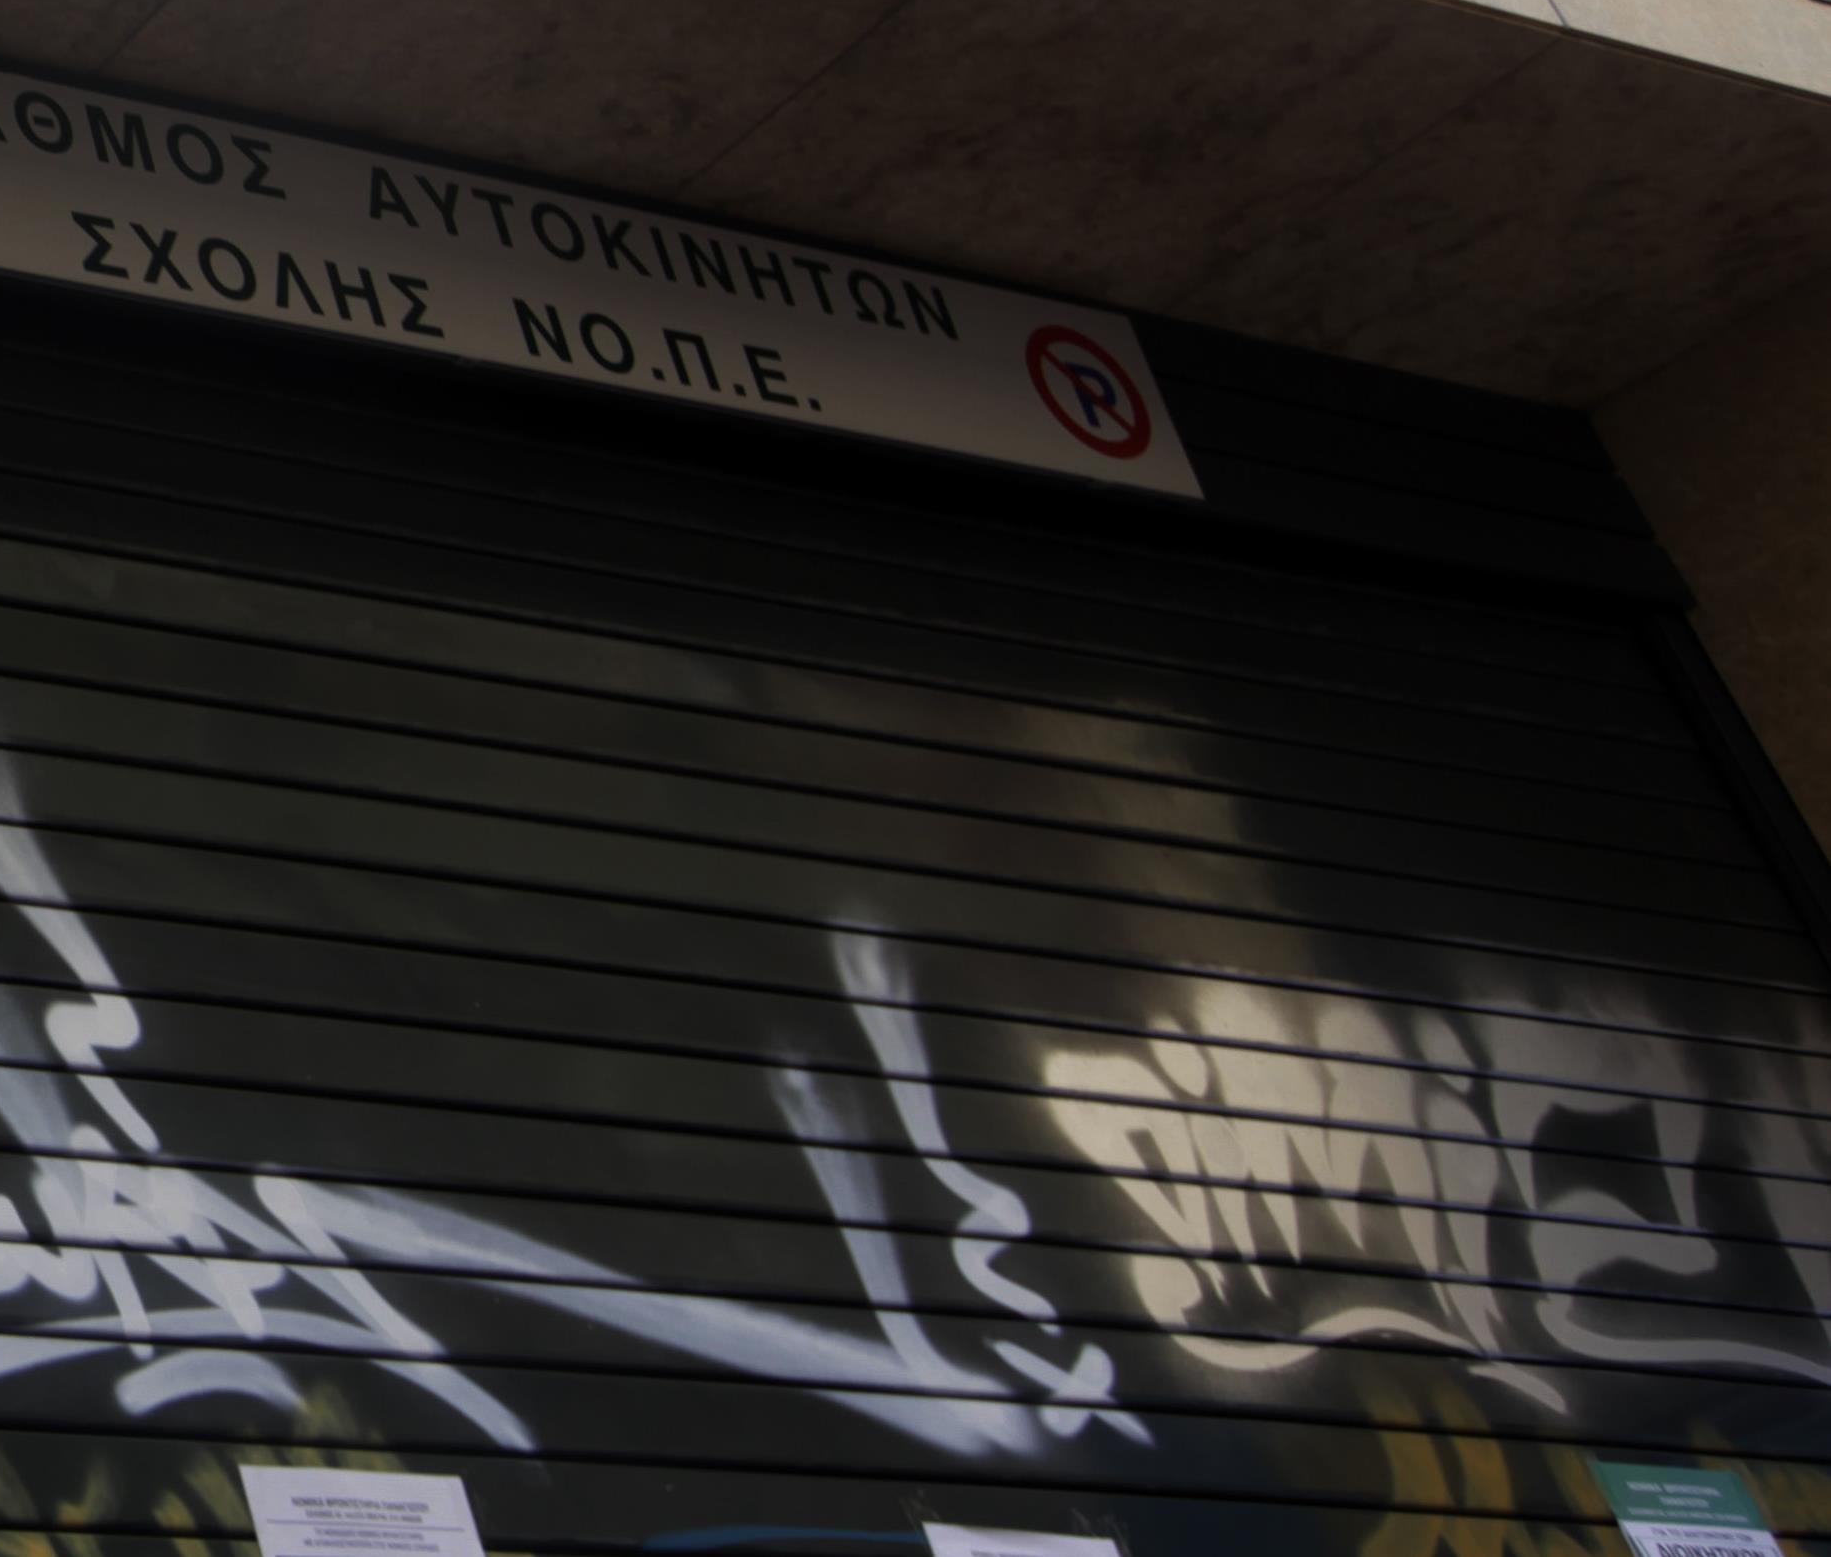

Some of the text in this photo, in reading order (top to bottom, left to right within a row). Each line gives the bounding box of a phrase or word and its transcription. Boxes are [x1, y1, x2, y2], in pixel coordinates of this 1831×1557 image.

[70, 210, 824, 413] ΣΧΟΛΗΣ ΝΟ.Π.Ε.
[367, 165, 960, 342] ΑΥΤΟΚΙΝΗΤΩΝ
